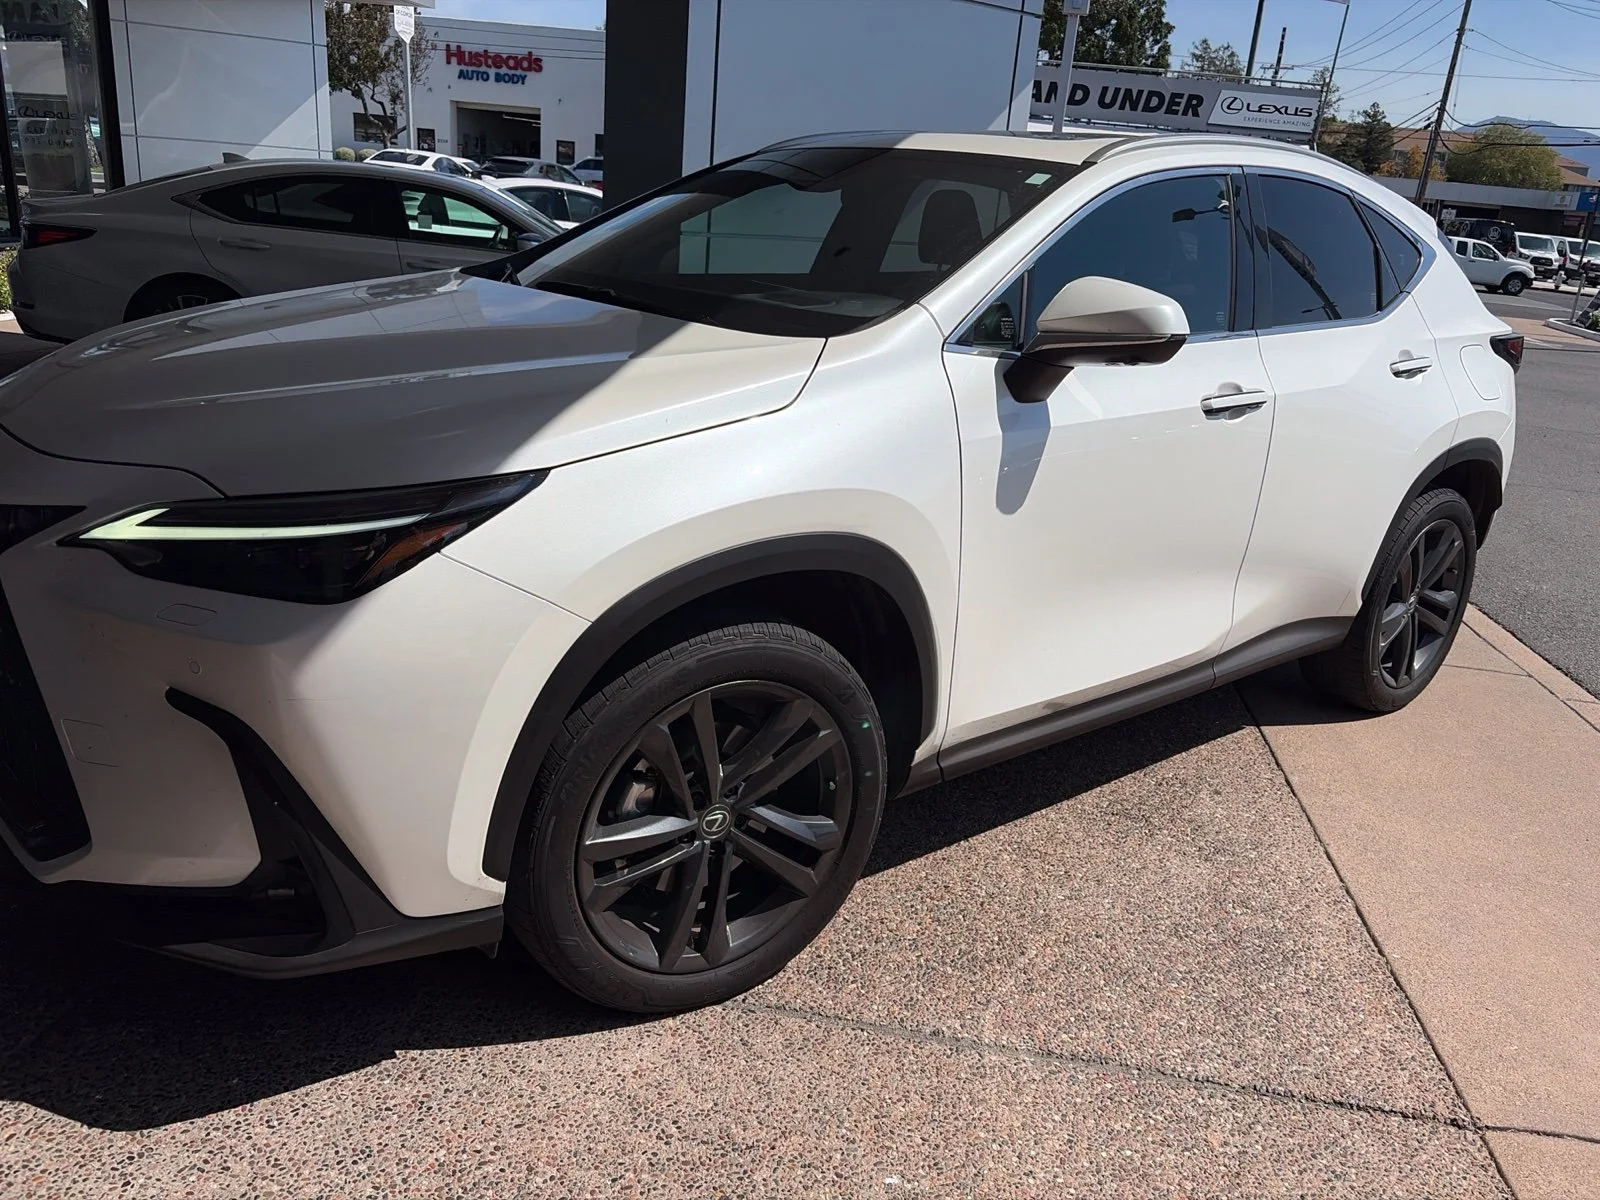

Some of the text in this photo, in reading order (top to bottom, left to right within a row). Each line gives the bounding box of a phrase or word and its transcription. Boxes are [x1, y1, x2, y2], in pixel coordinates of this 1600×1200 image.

[445, 43, 543, 73] Husteads
[458, 69, 527, 85] AUTO BODY
[1097, 85, 1204, 118] UNDER
[35, 110, 79, 121] LEXUS
[1246, 102, 1313, 118] LEXUS
[1243, 116, 1311, 128] EXPERIENCE AMAZING
